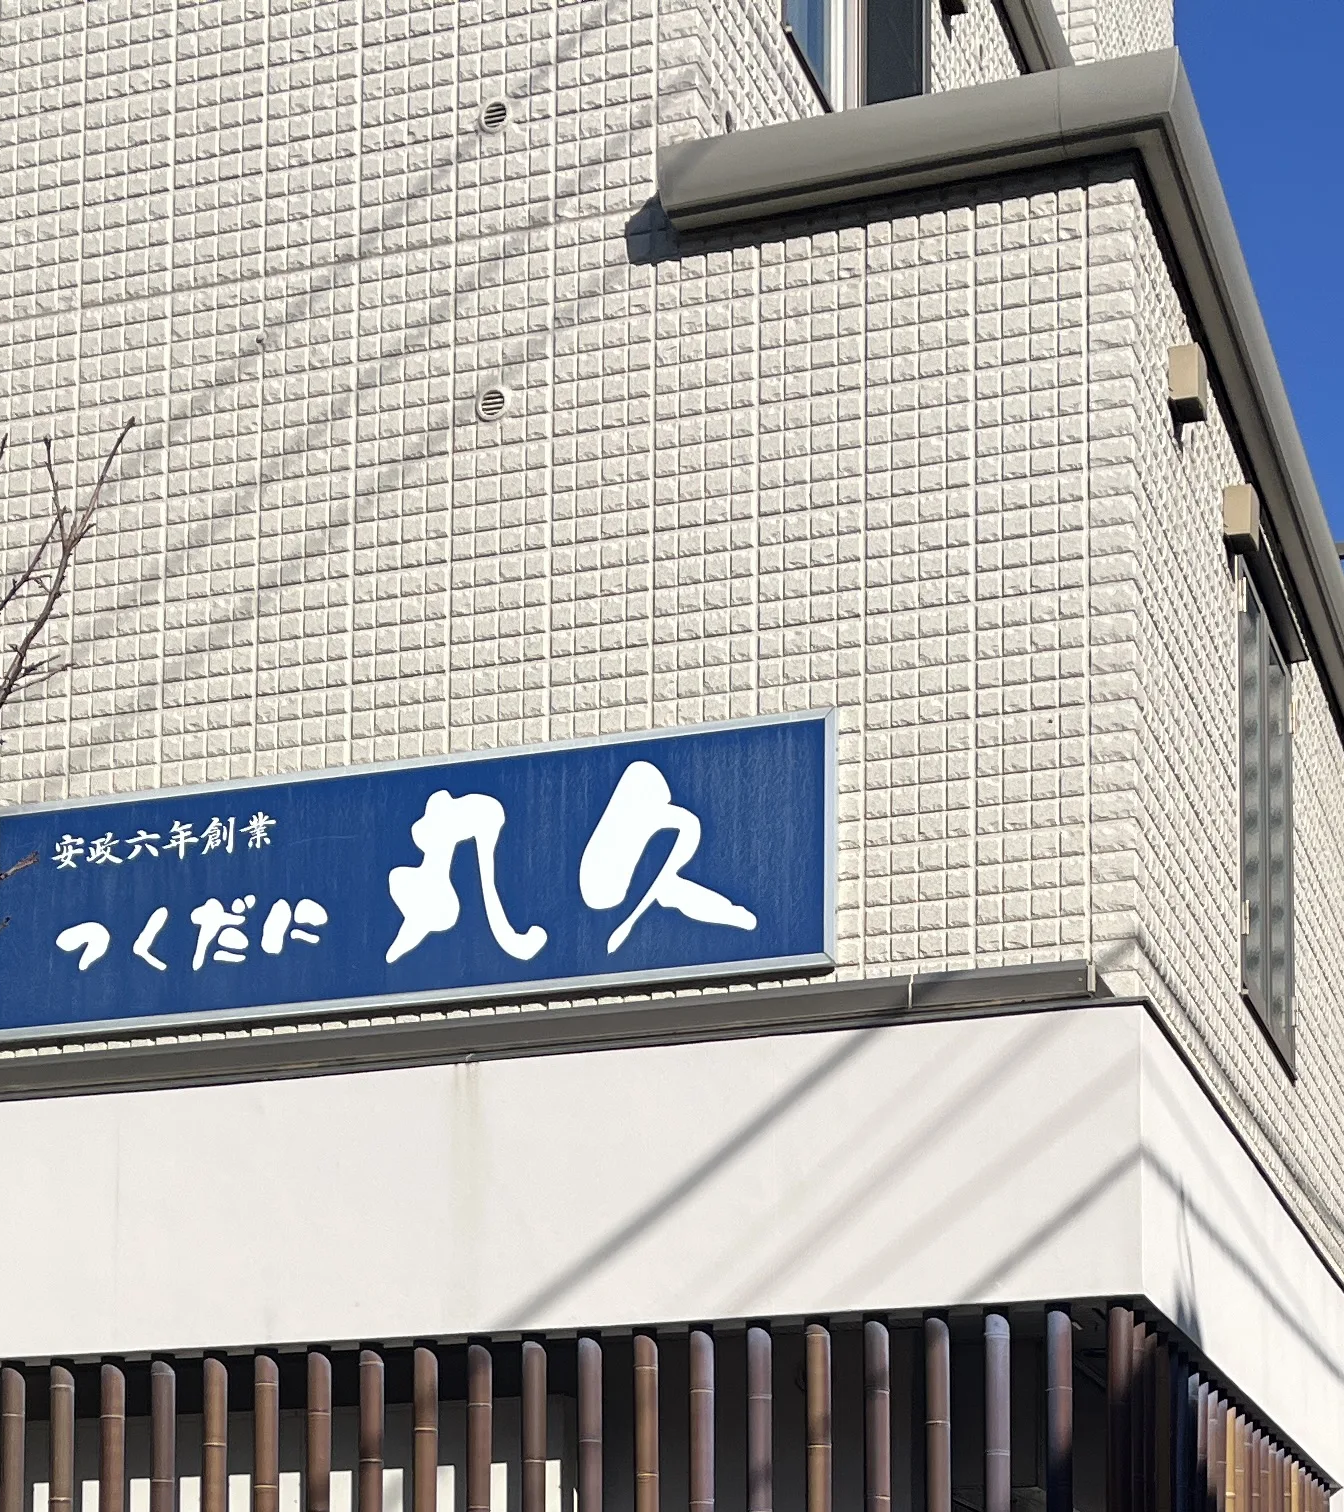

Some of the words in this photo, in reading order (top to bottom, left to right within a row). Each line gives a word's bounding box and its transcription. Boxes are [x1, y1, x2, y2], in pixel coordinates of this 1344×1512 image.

[51, 811, 276, 870] 安政六年創業
[385, 760, 757, 965] 丸久
[56, 895, 327, 971] つくだに
